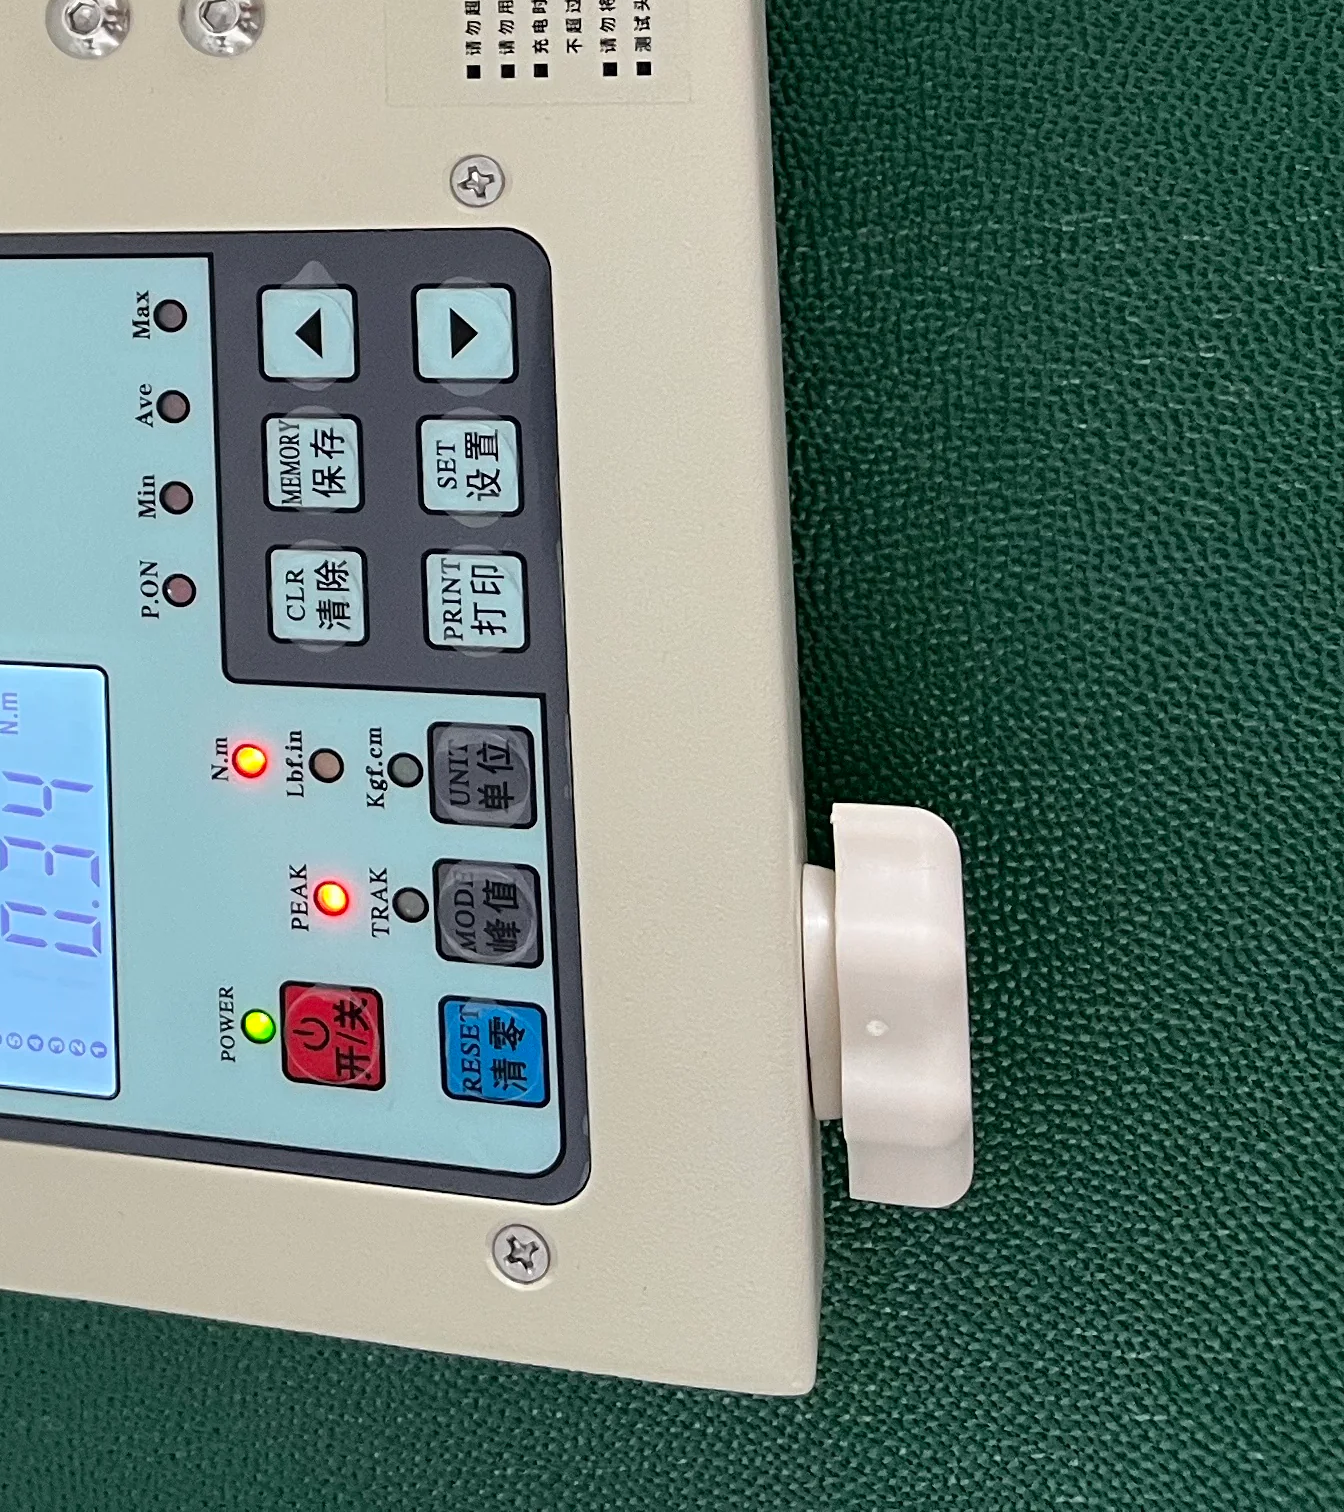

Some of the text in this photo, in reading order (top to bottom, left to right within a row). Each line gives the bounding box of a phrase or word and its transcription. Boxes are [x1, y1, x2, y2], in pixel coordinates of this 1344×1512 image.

[132, 290, 151, 340] Max
[135, 384, 153, 428] Ave
[137, 474, 156, 519] Min
[278, 419, 303, 505] MEMORY
[309, 427, 347, 498] 保存
[436, 440, 457, 489] SET
[464, 429, 502, 500] 设置
[139, 560, 160, 619] P.ON
[285, 568, 305, 622] CLR
[315, 559, 351, 630] 清除
[440, 558, 463, 641] PRINT
[469, 563, 506, 636] 打印
[212, 737, 229, 782] N.m
[286, 730, 305, 798] Lbf.in
[367, 727, 386, 809] Kgf.cm
[449, 739, 470, 806] UNIT
[476, 740, 514, 810] 单位
[0, 771, 101, 957] 0.34
[290, 864, 309, 932] PEAK
[370, 867, 389, 938] TRAK
[456, 870, 477, 952] MODE
[483, 879, 521, 952] 峰值
[219, 986, 236, 1062] POWER
[334, 997, 371, 1080] 开/关
[460, 1004, 482, 1093] RESET
[488, 1015, 528, 1092] 清零
